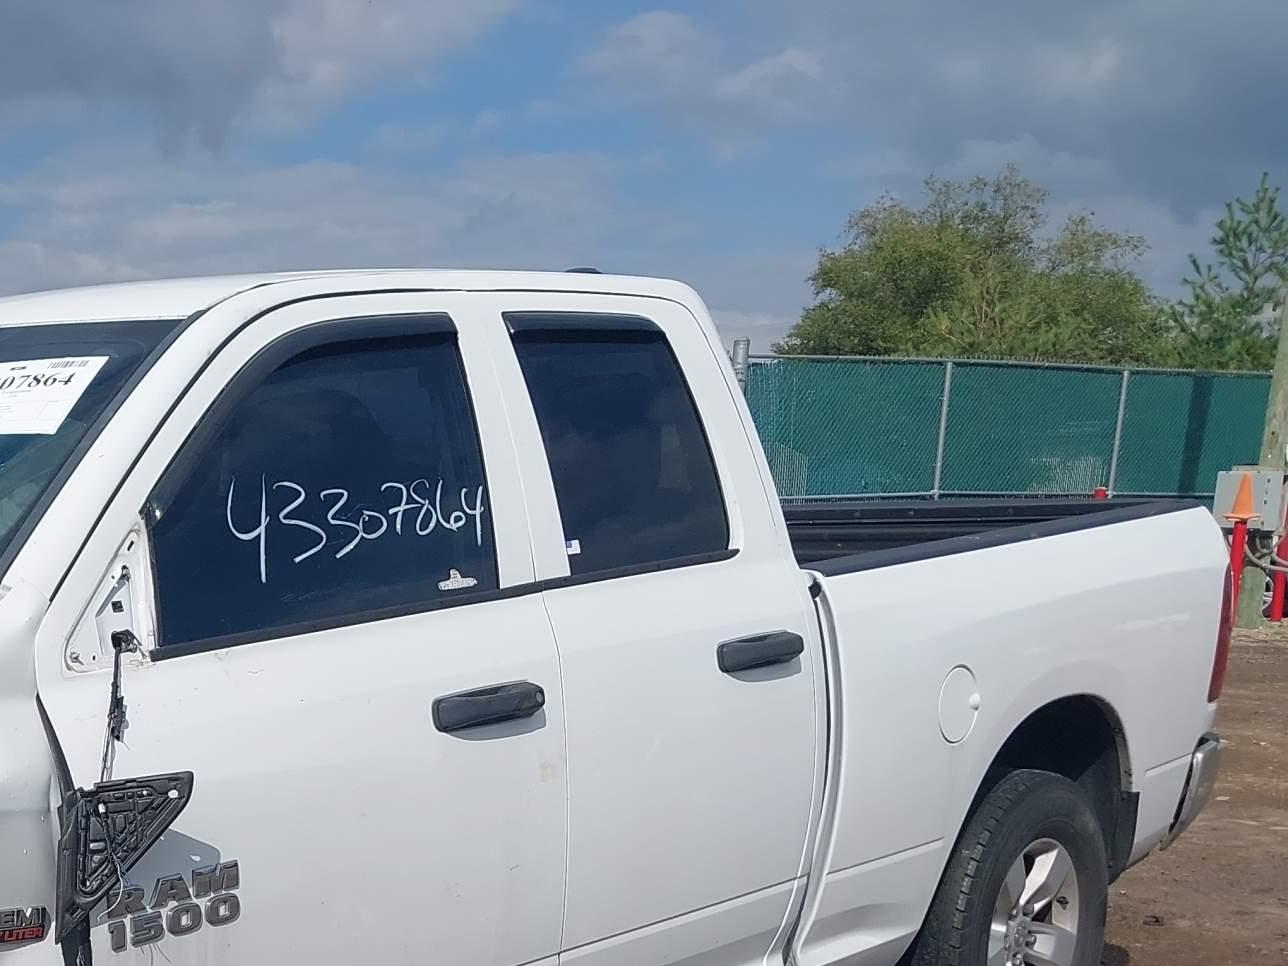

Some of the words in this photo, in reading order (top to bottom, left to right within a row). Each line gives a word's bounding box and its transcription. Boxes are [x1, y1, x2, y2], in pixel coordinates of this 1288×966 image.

[227, 473, 485, 583] 43307864
[107, 859, 240, 920] RAM
[107, 892, 241, 953] 1500
